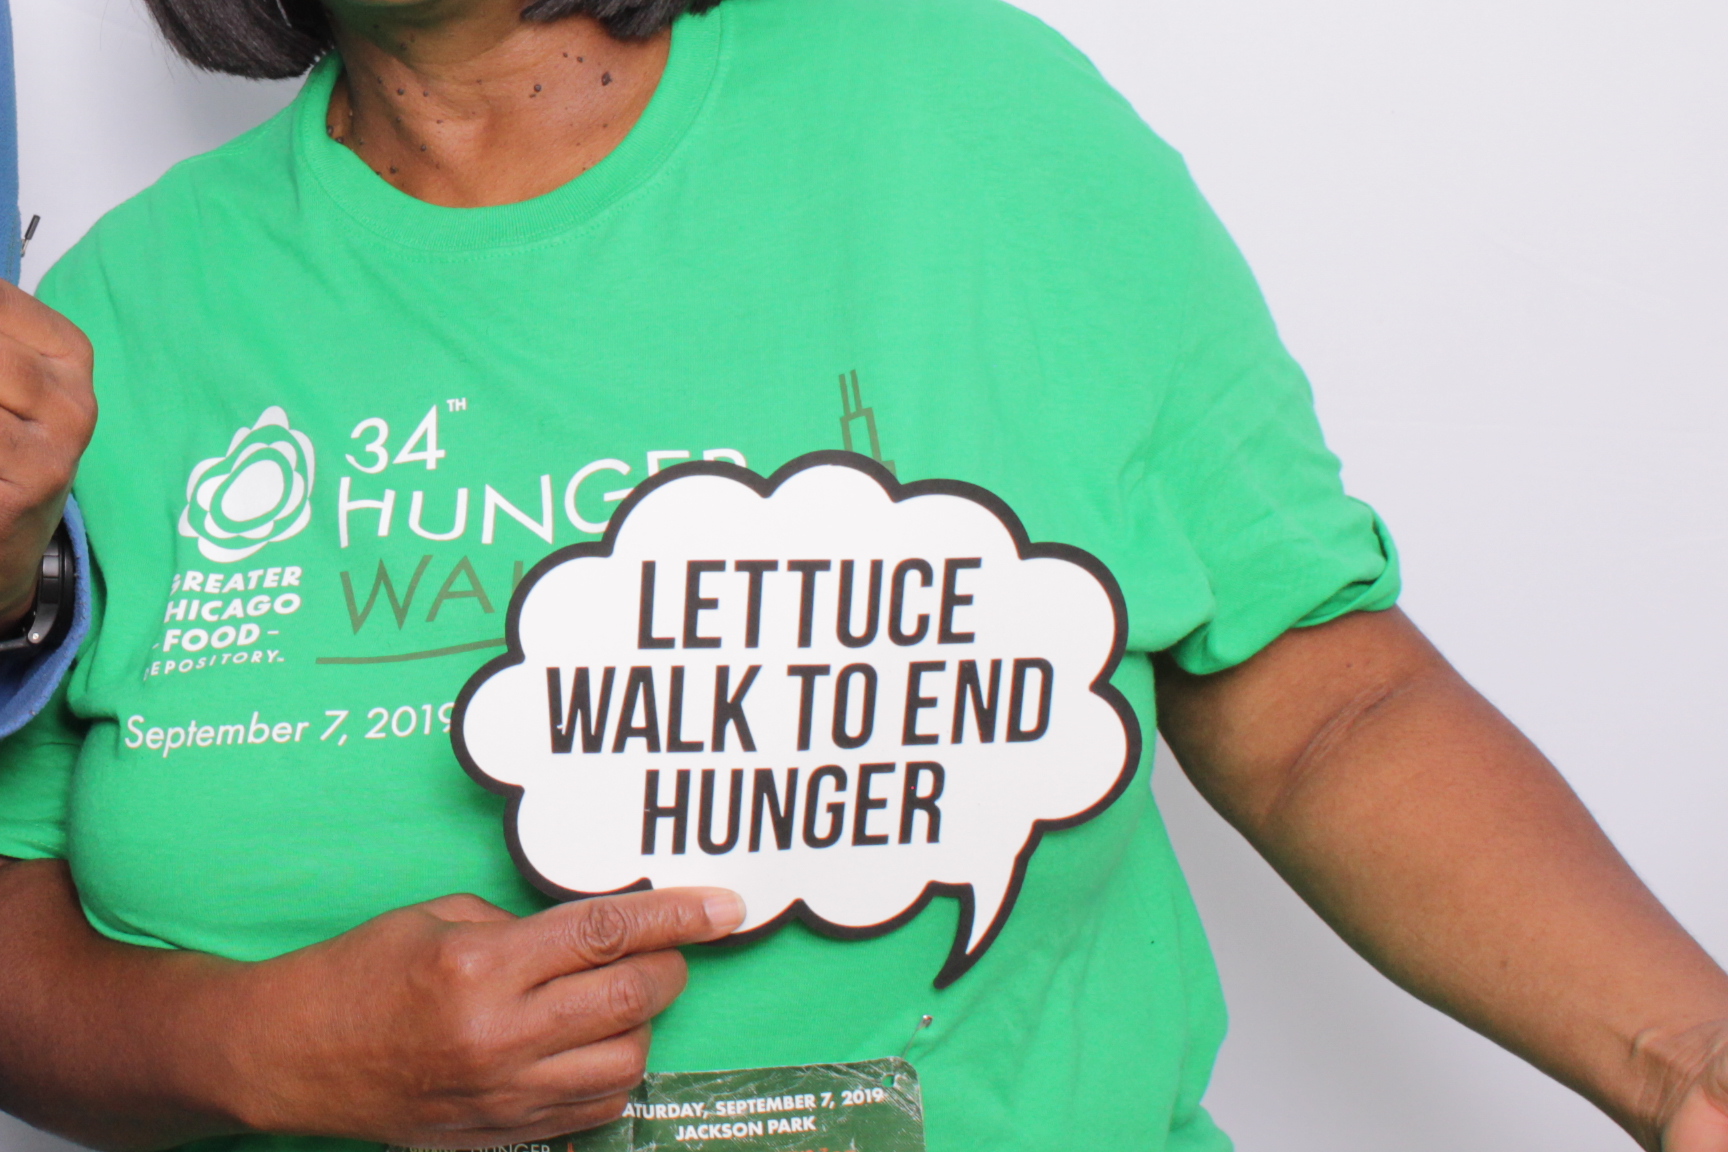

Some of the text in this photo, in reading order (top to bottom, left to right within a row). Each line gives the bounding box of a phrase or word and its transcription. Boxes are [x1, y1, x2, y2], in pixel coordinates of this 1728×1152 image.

[337, 448, 748, 549] HUNG
[163, 592, 302, 624] HICAGO
[339, 554, 524, 636] WA
[636, 556, 983, 650] LETTUCE
[124, 702, 456, 758] September 7, 2019
[544, 656, 1055, 755] WALK TO END
[639, 760, 946, 856] HUNGER
[621, 1087, 885, 1120] ATURDAY, SEPTEMBER 7, 2019
[675, 1115, 817, 1141] JACKSON PARK
